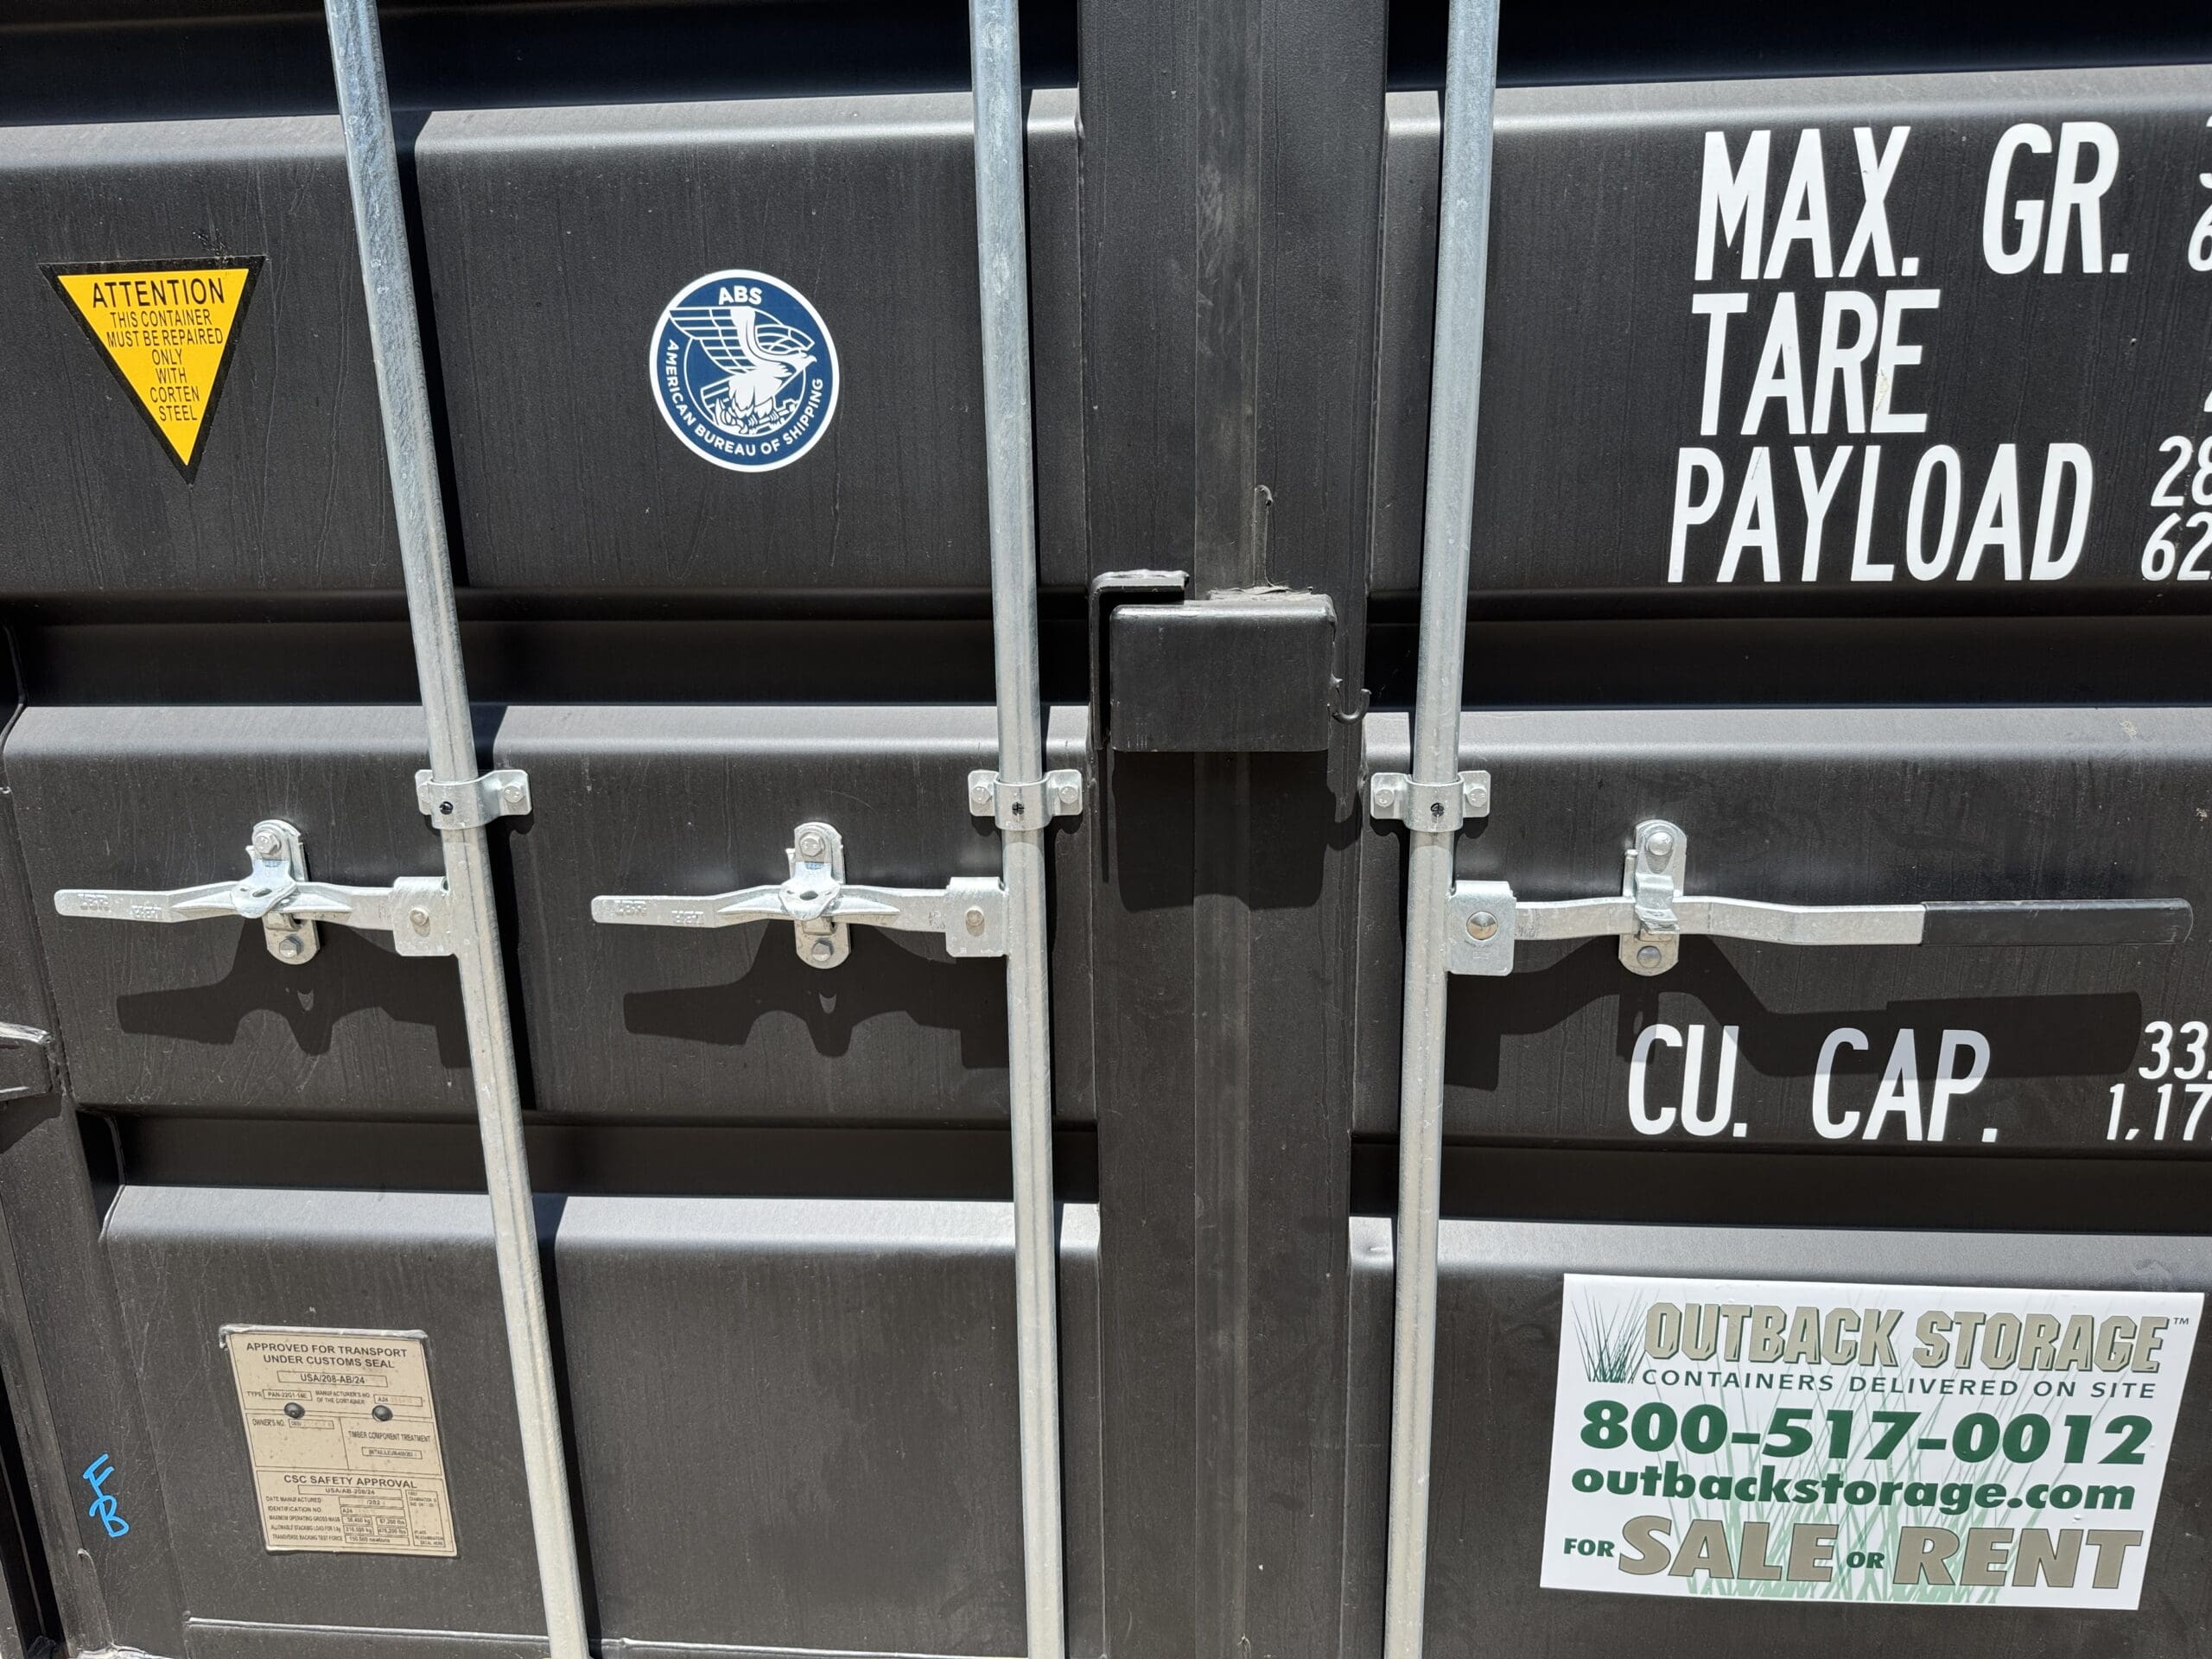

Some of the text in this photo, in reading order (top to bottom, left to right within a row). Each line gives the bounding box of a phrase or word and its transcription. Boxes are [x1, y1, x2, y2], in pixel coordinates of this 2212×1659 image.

[1694, 125, 1919, 281] MAX.
[1982, 121, 2130, 274] GR.
[92, 277, 225, 308] ATTENTION
[718, 285, 763, 306] ABS
[110, 308, 213, 328] THIS CONTAINER
[106, 327, 224, 348] MUST BE REPAIRED
[151, 348, 183, 365] ONLY
[1692, 289, 1941, 435] TARE
[155, 367, 188, 385] WITH
[149, 386, 200, 403] CORTEN
[664, 338, 823, 456] AMERICAN BUREAU OF SHIPPING
[158, 404, 198, 422] STEEL
[1668, 442, 2094, 583] PAYLOAD
[2141, 512, 2212, 581] 62
[1628, 1023, 1999, 1143] CU. CAP.
[2107, 1084, 2212, 1141] 1,17
[246, 1343, 407, 1357] APPROVED FOR TRANSPORT
[1643, 1302, 1904, 1367] OUTBACK
[1912, 1310, 2171, 1374] STORAGE
[264, 1355, 396, 1369] UNDER CUSTOMS SEAL
[300, 1374, 365, 1384] USA/208-AB/24
[1642, 1369, 2156, 1399] CONTAINERS DELIVERED ON SITE
[1580, 1400, 2152, 1465] 800-517-0012
[283, 1475, 417, 1489] CSC SAFETY APPROVAL
[1571, 1460, 2136, 1516] outbackstorage.com
[1563, 1515, 2144, 1590] FOR SALE OR RENT
